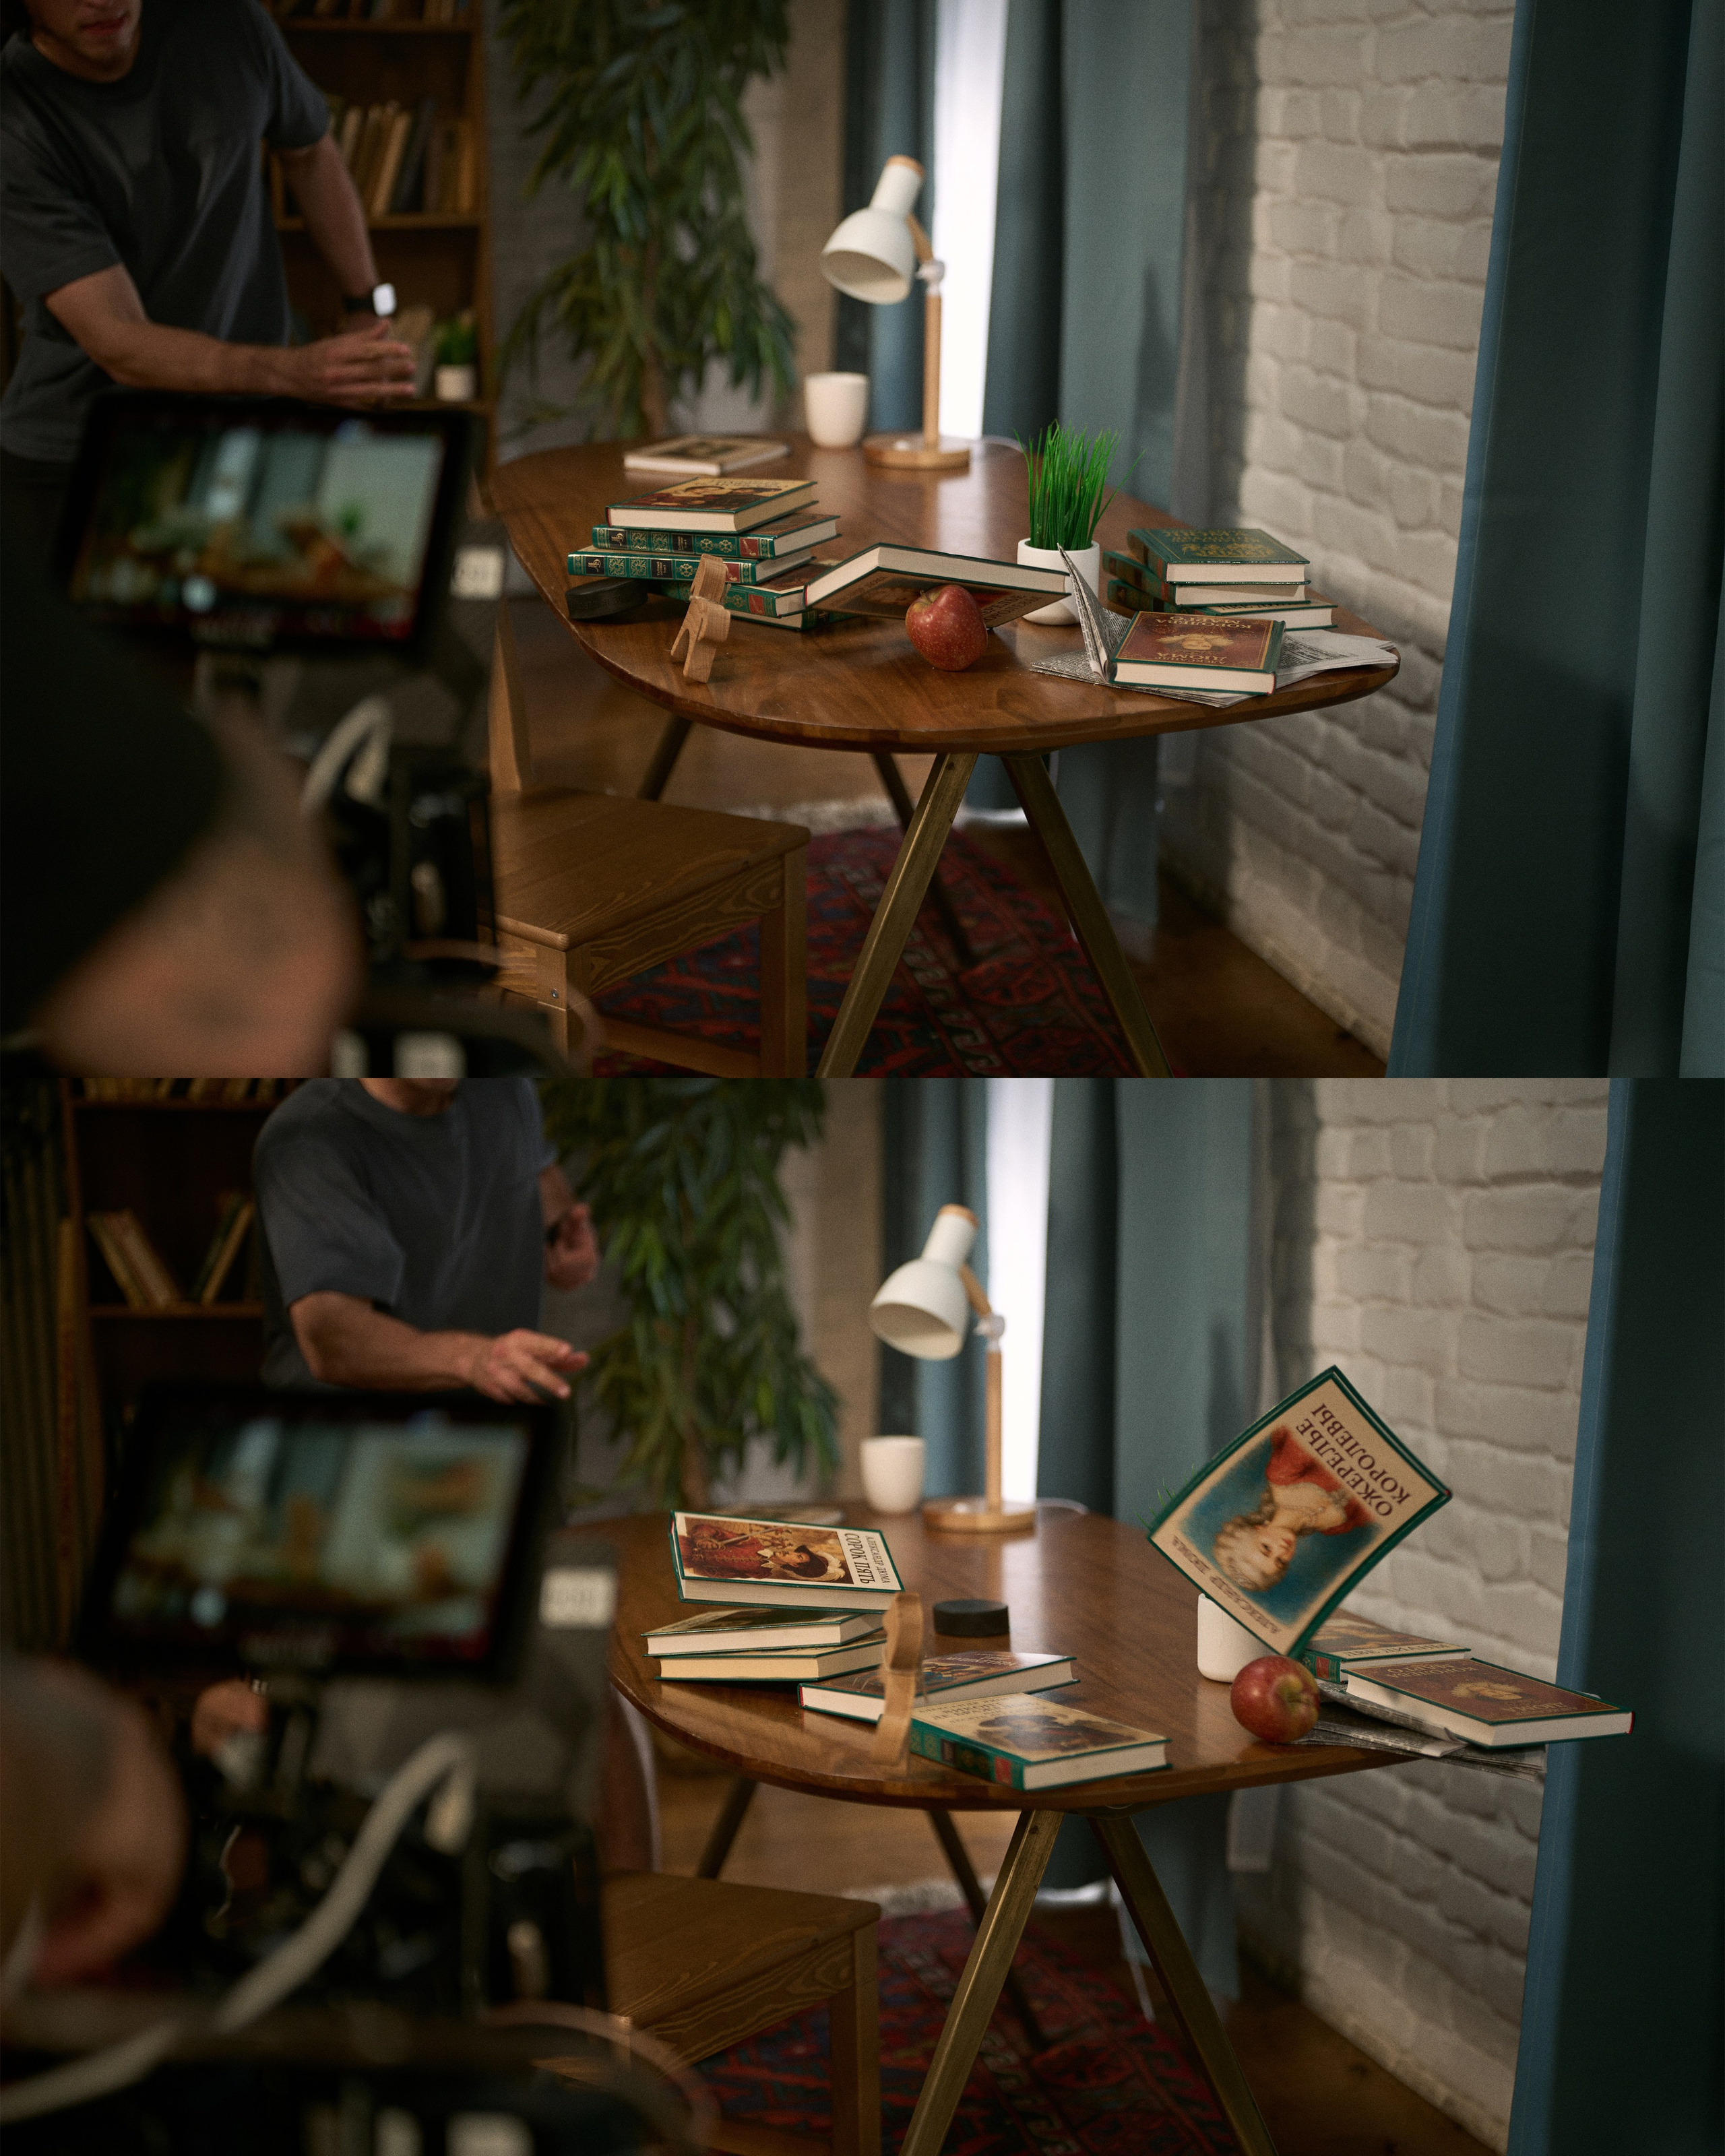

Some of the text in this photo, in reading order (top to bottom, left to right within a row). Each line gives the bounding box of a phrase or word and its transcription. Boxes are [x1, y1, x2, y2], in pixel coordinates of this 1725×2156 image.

[1156, 619, 1251, 629] КОРОЛЕВА
[1170, 615, 1240, 625] МАРГО
[1156, 652, 1227, 660] ДЮМА
[1296, 1418, 1393, 1517] ОЖЕРЕЛЬЕ
[1311, 1403, 1411, 1504] КОРОЛЕВЫ
[844, 1533, 875, 1584] СОРОК ПЯТЬ
[865, 1536, 891, 1583] АЛЕКСАНДР ДЮМА
[1172, 1535, 1280, 1634] АЛЕКСАНДР ДЮМА
[1387, 1663, 1455, 1674] МАРГО
